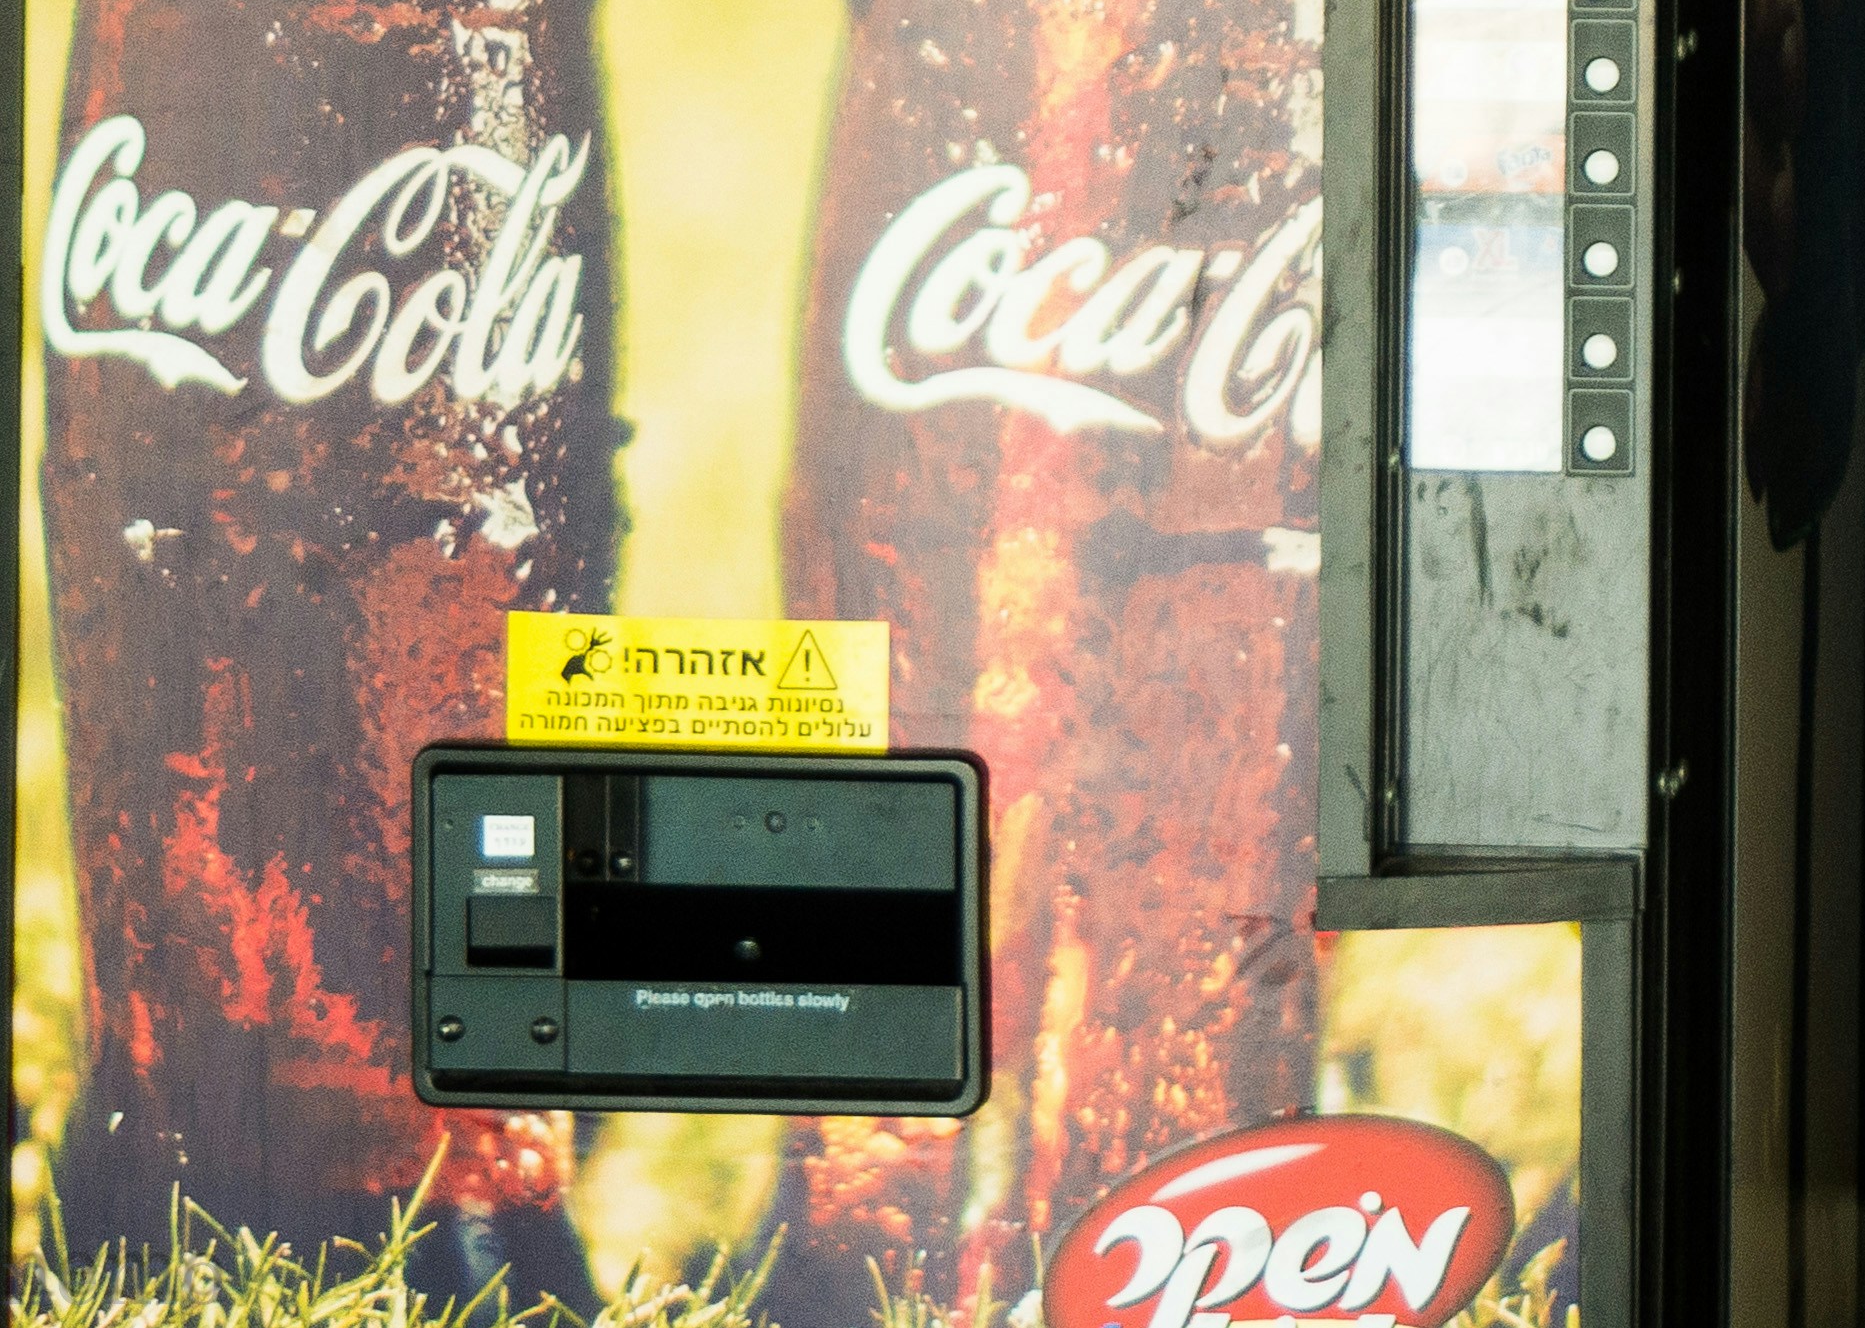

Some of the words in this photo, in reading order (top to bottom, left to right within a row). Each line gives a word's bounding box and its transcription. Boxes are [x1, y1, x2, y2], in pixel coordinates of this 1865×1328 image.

[39, 114, 592, 405] Coca-Cola
[624, 647, 766, 677] אזהרה!
[547, 690, 625, 709] המכונה
[635, 691, 689, 715] מתוך
[699, 693, 758, 712] גניבה
[769, 696, 845, 714] נסיונות
[520, 712, 589, 731] חמורה
[599, 713, 682, 735] בפציעה
[693, 713, 788, 737] להסתיים
[799, 716, 872, 738] עלולים
[482, 874, 534, 891] change
[635, 989, 690, 1005] Please
[692, 993, 735, 1008] open
[737, 991, 794, 1006] bottles
[797, 992, 850, 1012] slowly
